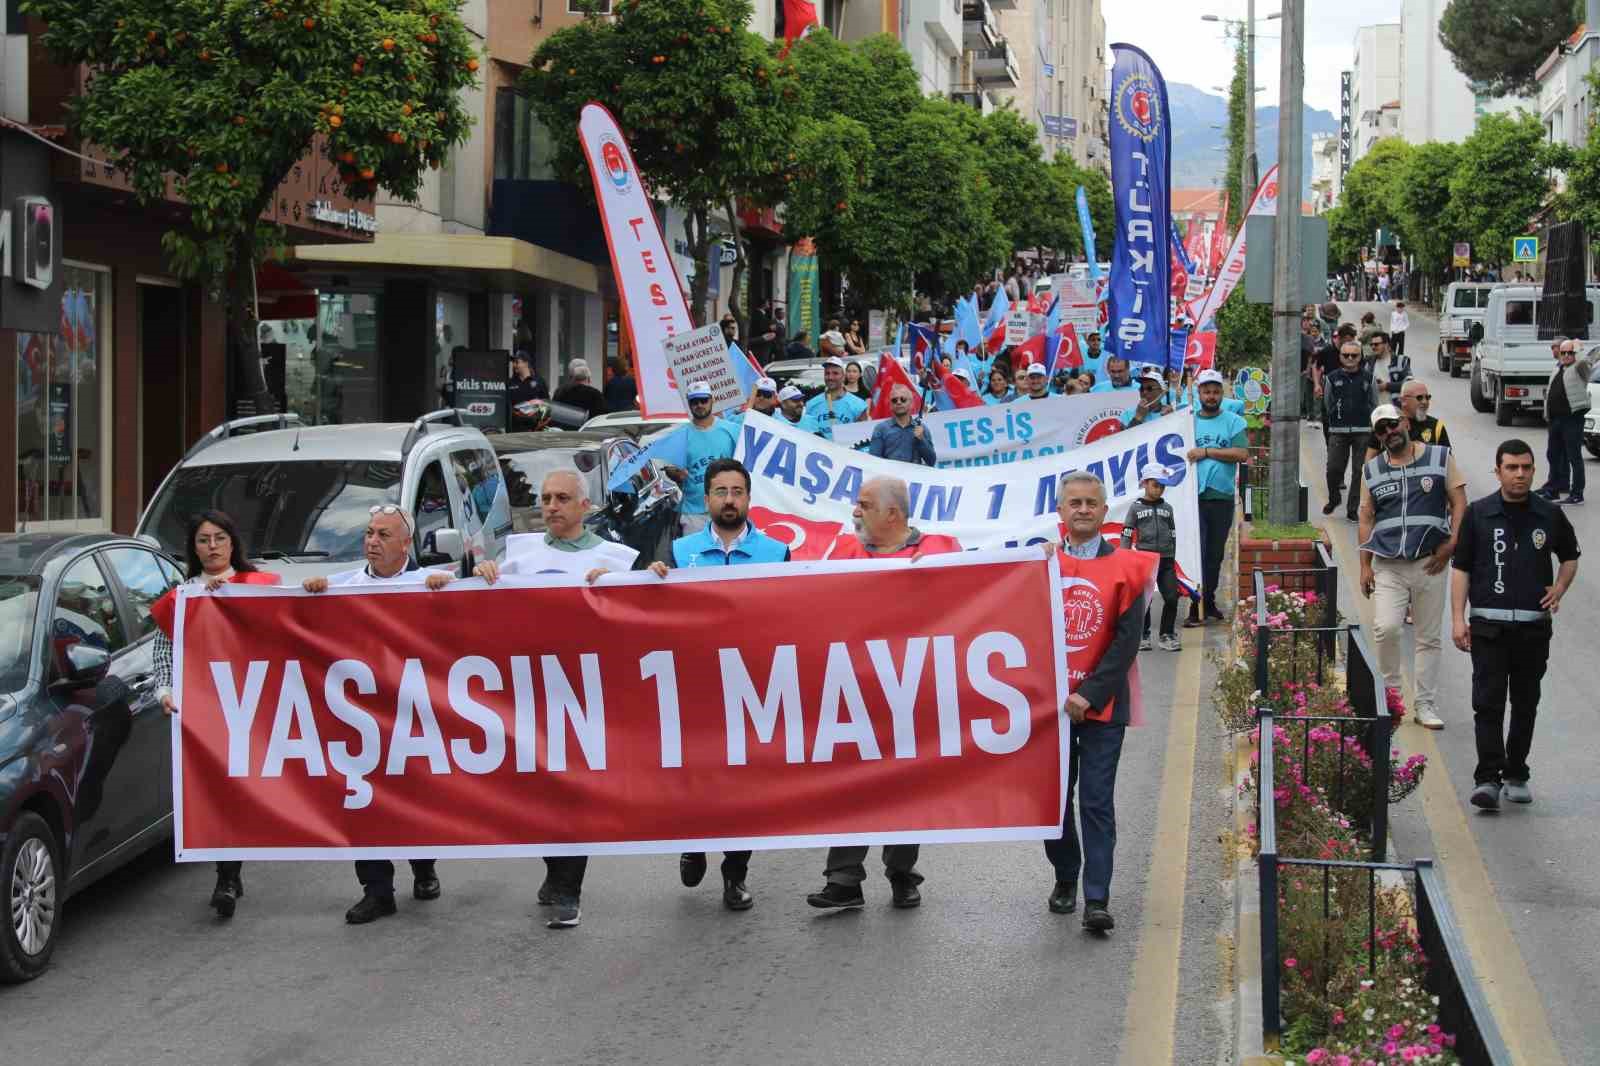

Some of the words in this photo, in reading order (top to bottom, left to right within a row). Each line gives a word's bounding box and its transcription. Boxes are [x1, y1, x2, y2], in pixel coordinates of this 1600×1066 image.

[481, 381, 506, 391] TAVA
[944, 409, 1034, 445] TES-İŞ
[740, 424, 963, 521] YAŞAIN
[986, 483, 1007, 520] 1
[1493, 528, 1506, 593] POLİS
[208, 652, 607, 809] YAŞASIN
[639, 650, 683, 768] 1
[718, 631, 1032, 766] MAYIS
